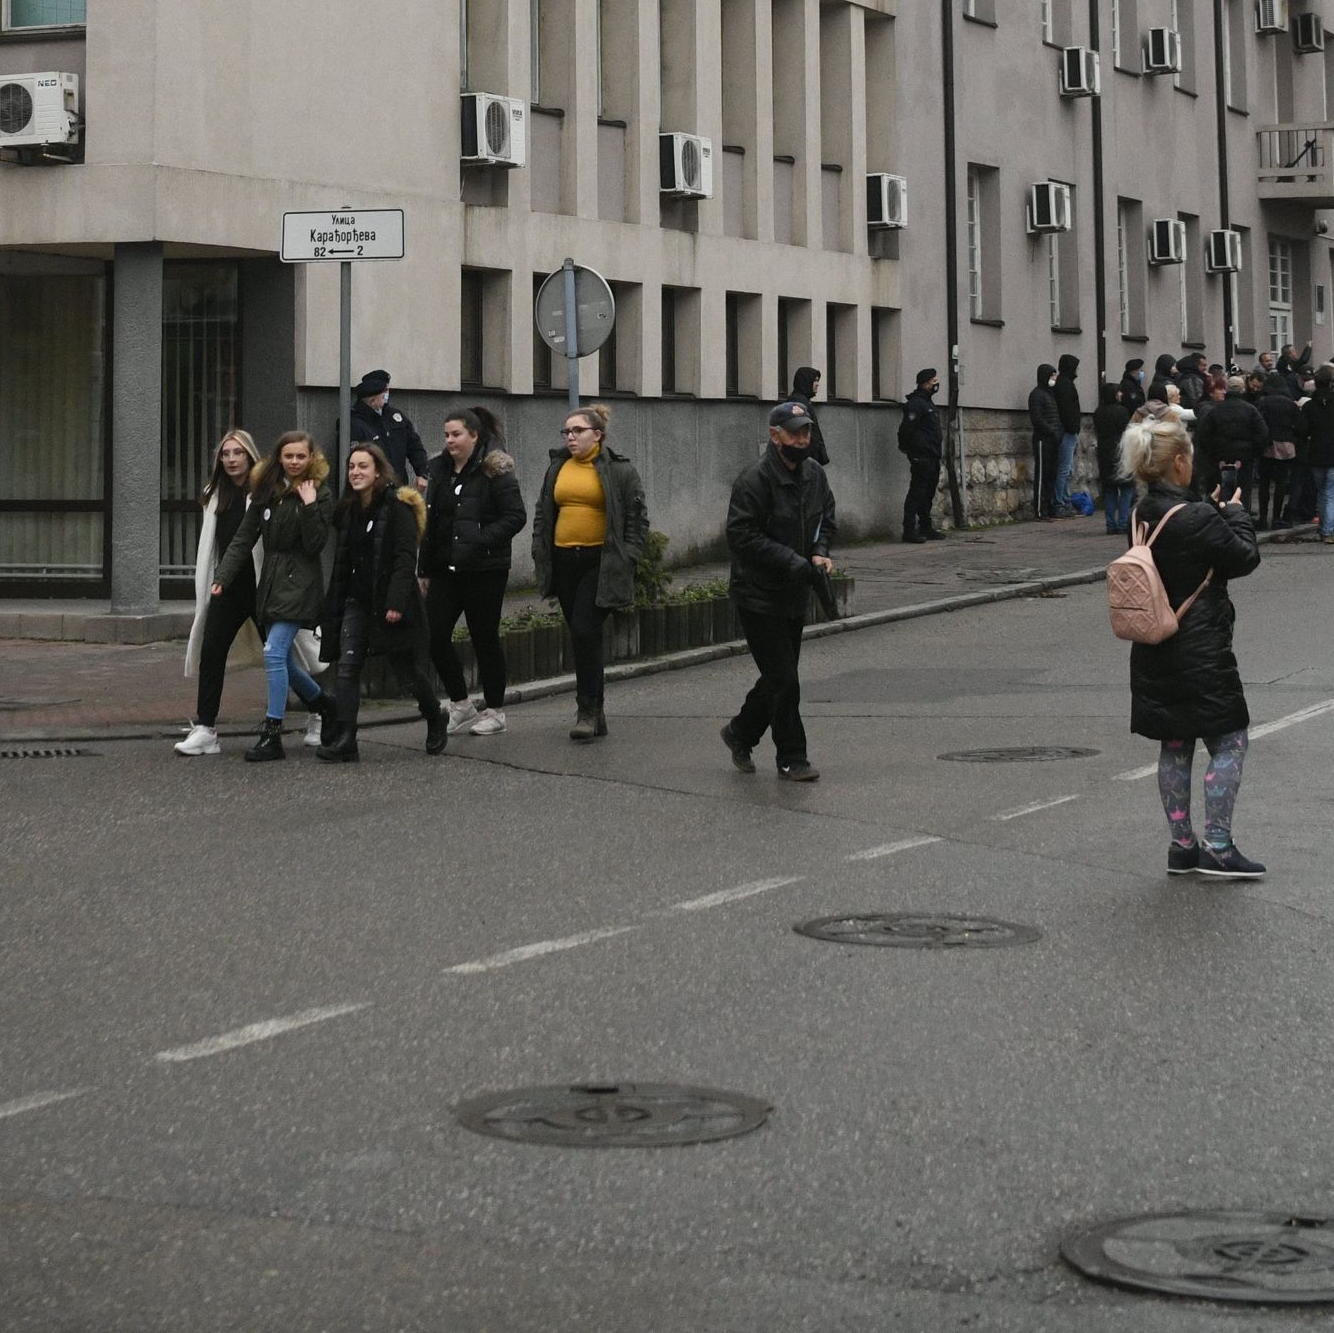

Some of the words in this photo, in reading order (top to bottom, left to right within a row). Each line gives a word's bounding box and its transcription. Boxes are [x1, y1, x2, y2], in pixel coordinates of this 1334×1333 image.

[331, 215, 356, 226] Улица
[310, 228, 376, 245] Карађорђева
[314, 247, 326, 257] 82
[357, 245, 364, 256] 2
